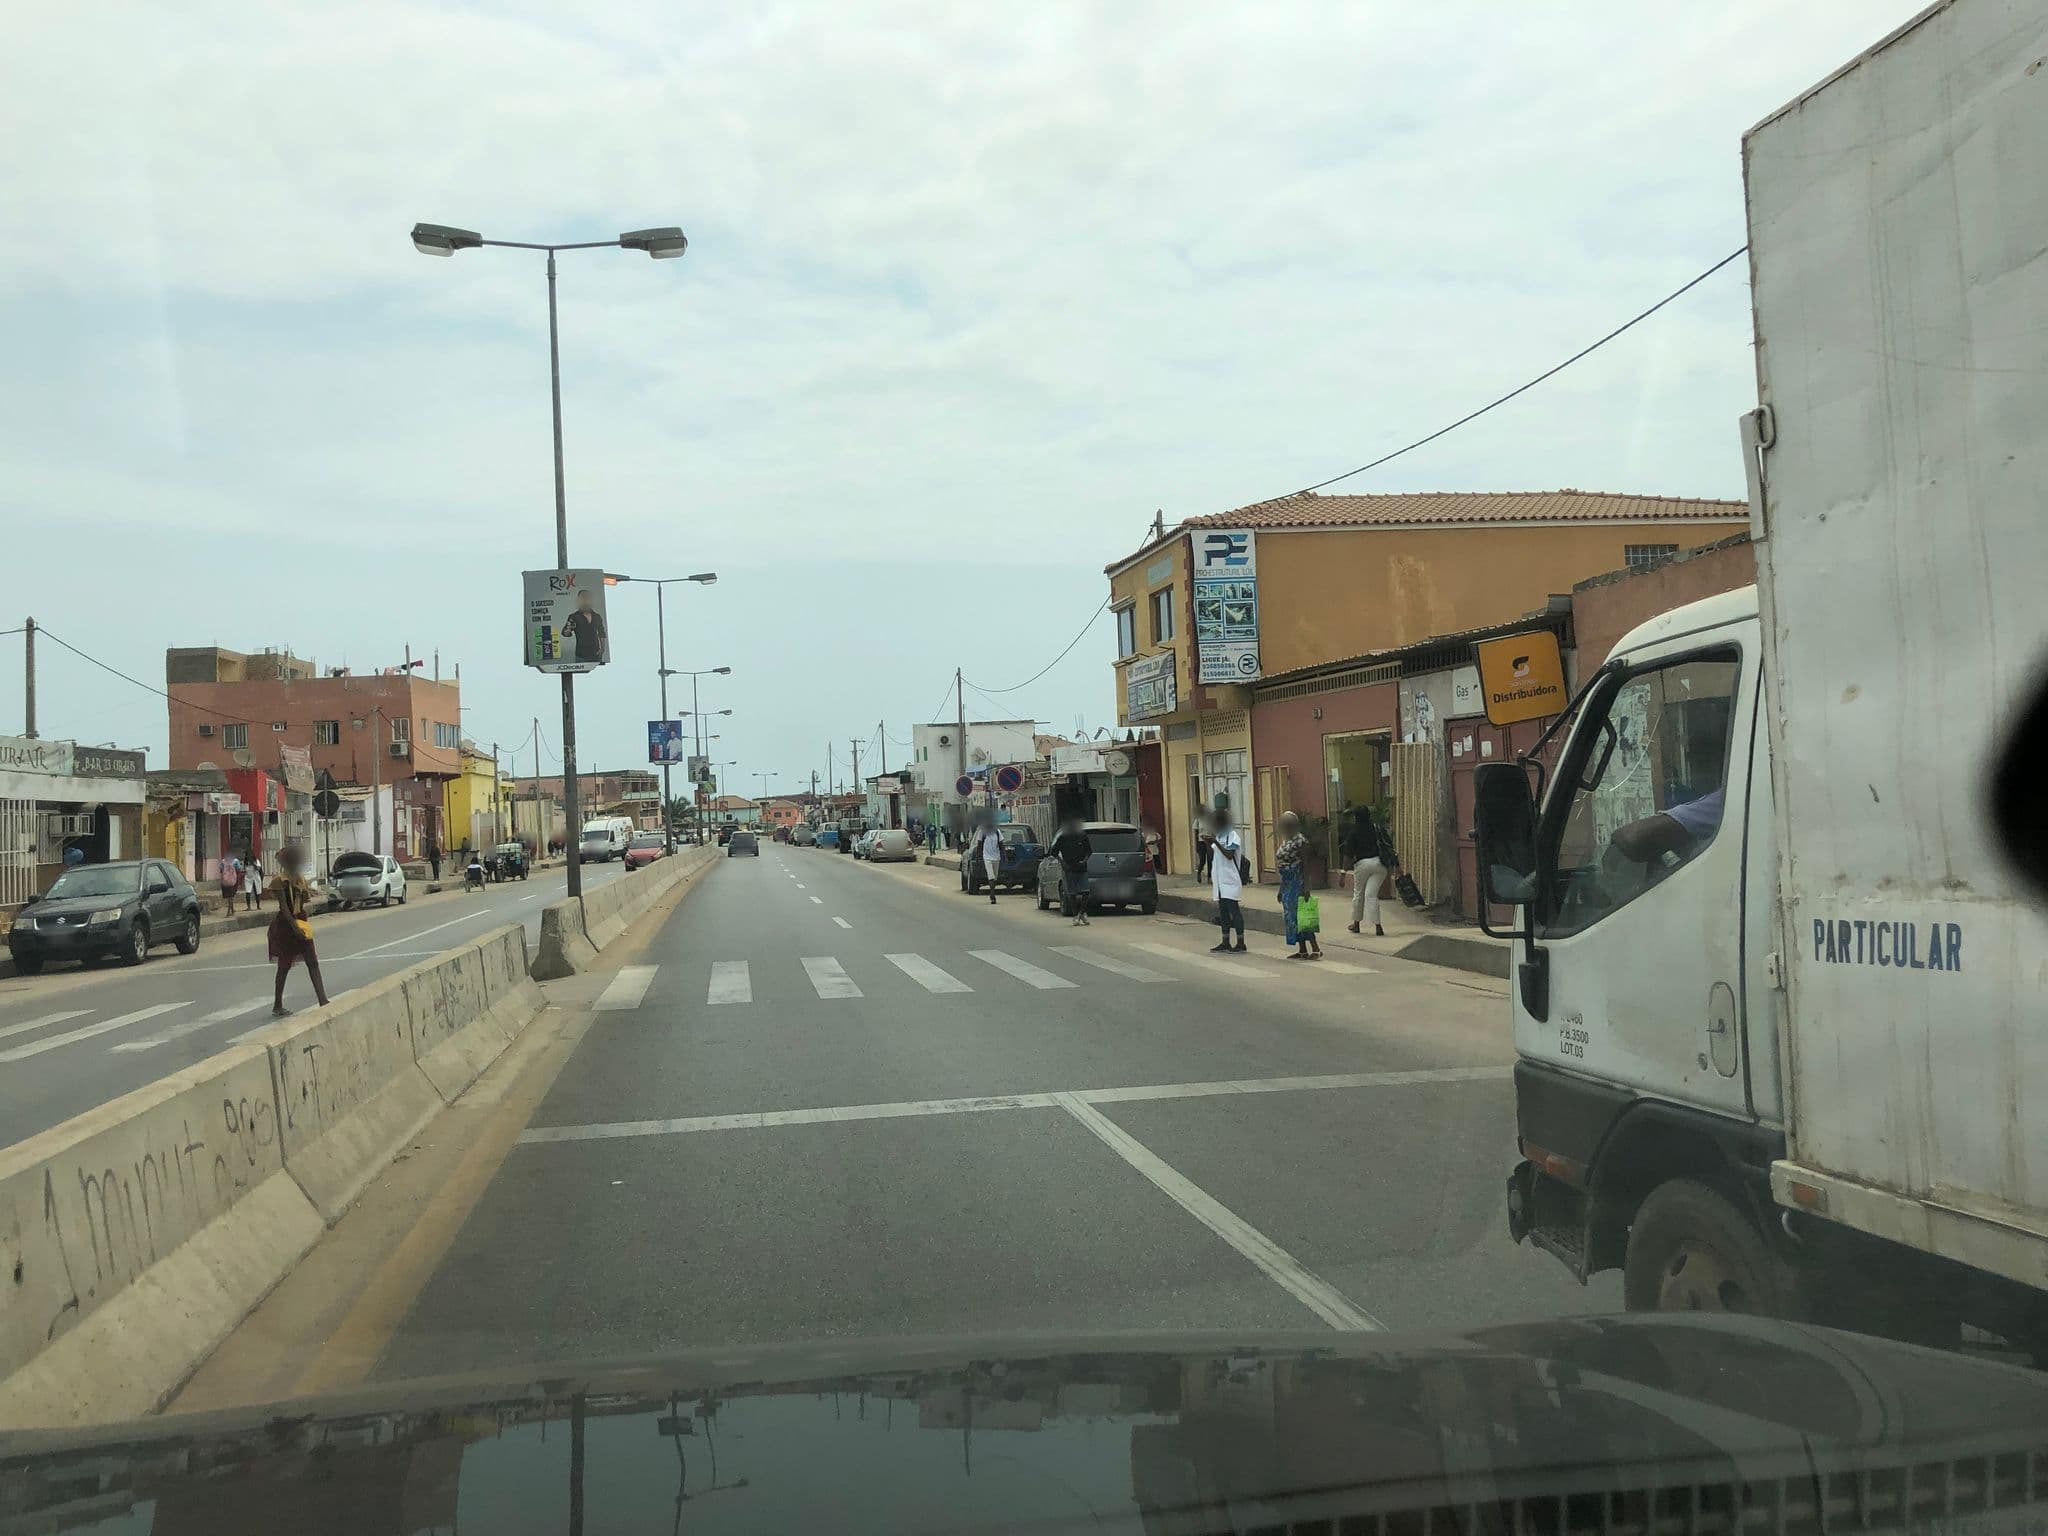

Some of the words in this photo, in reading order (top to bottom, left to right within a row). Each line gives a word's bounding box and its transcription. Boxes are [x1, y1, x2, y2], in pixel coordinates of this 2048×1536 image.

[1456, 685, 1469, 697] Gas
[1493, 684, 1557, 703] Distribuidora
[1813, 918, 1962, 971] PARTICULAR
